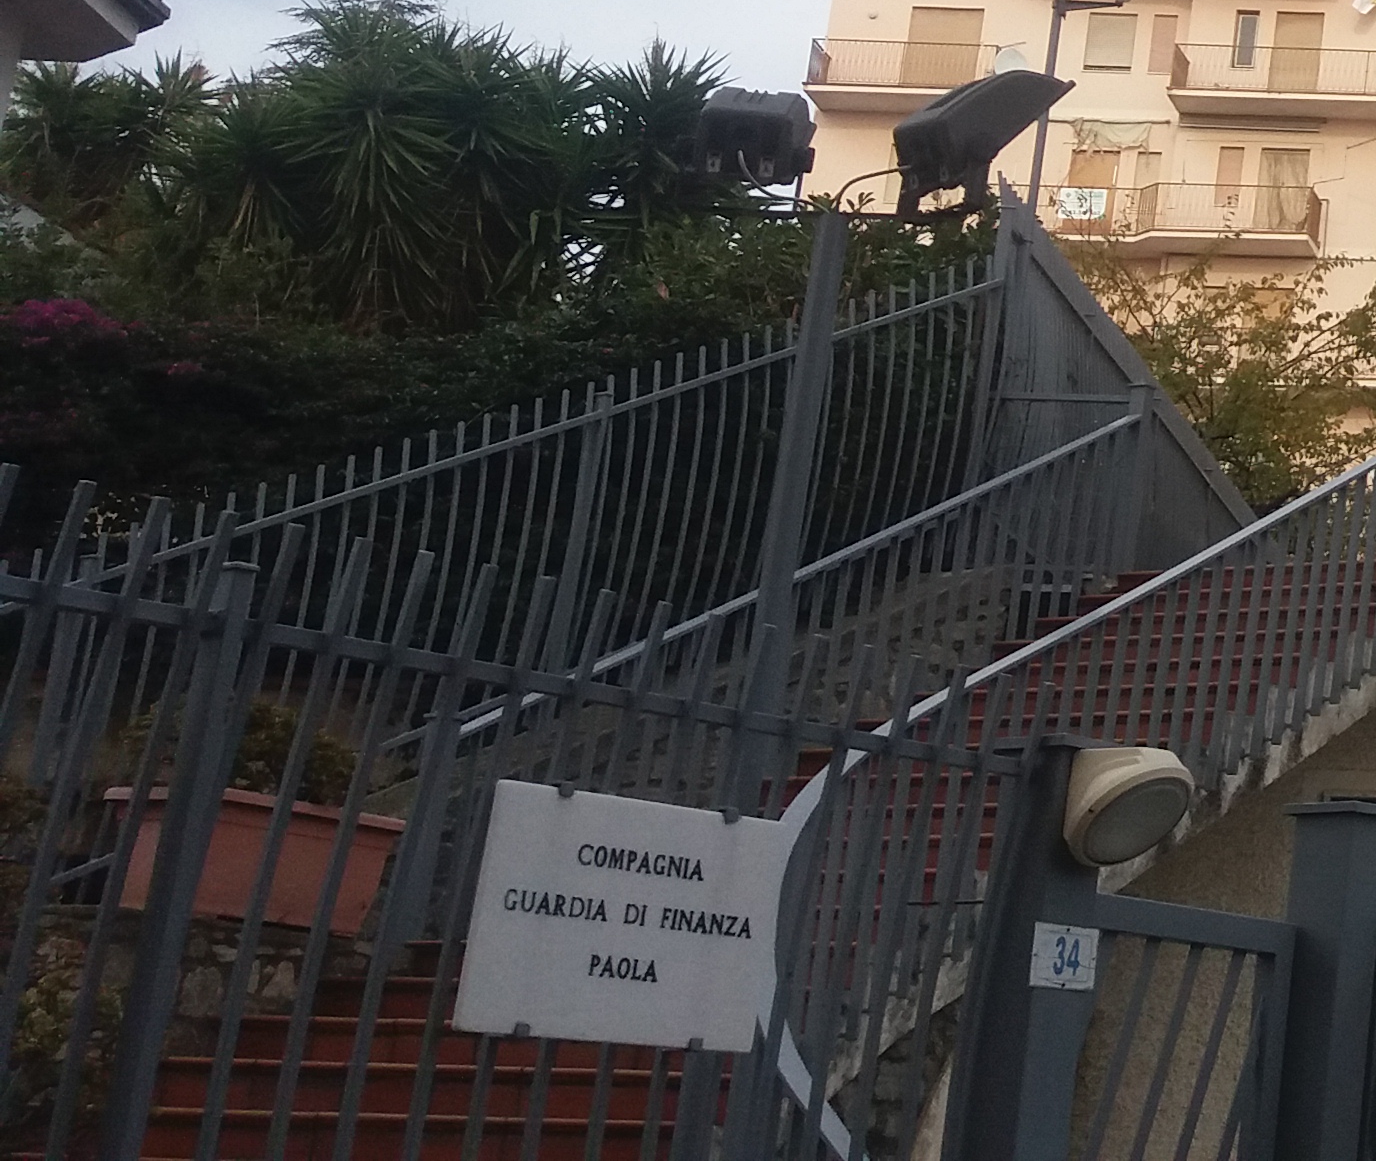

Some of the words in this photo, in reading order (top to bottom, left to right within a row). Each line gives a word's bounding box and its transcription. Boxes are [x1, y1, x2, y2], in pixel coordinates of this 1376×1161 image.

[577, 844, 704, 881] COMPAGNIA
[504, 889, 608, 922] GUARDIA
[623, 903, 648, 927] DI
[660, 907, 752, 939] FINANZA
[588, 954, 658, 983] PAOLA
[1053, 936, 1080, 976] 34
